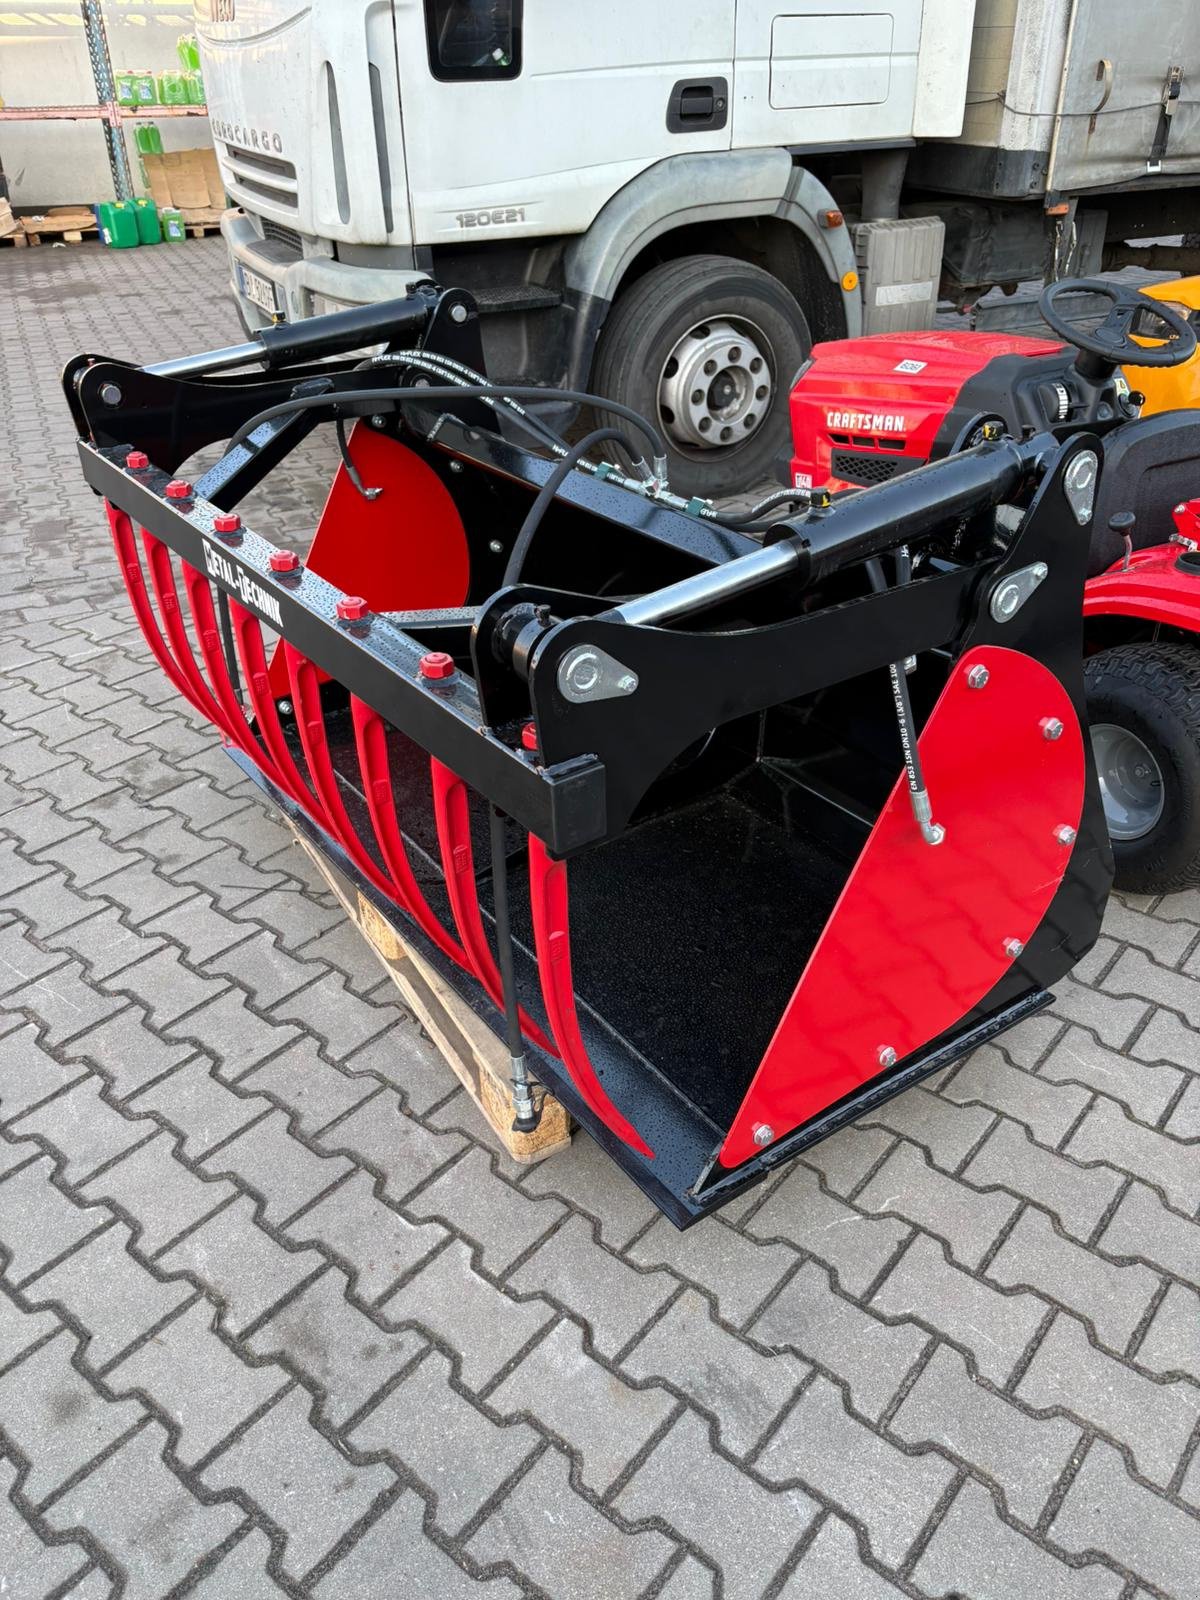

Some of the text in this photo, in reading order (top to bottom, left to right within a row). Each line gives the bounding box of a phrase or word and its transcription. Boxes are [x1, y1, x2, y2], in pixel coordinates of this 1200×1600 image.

[211, 119, 283, 153] EUROCARGO
[456, 208, 526, 228] 120E21
[827, 412, 905, 431] CRAFTSMAN
[891, 679, 900, 694] SAE
